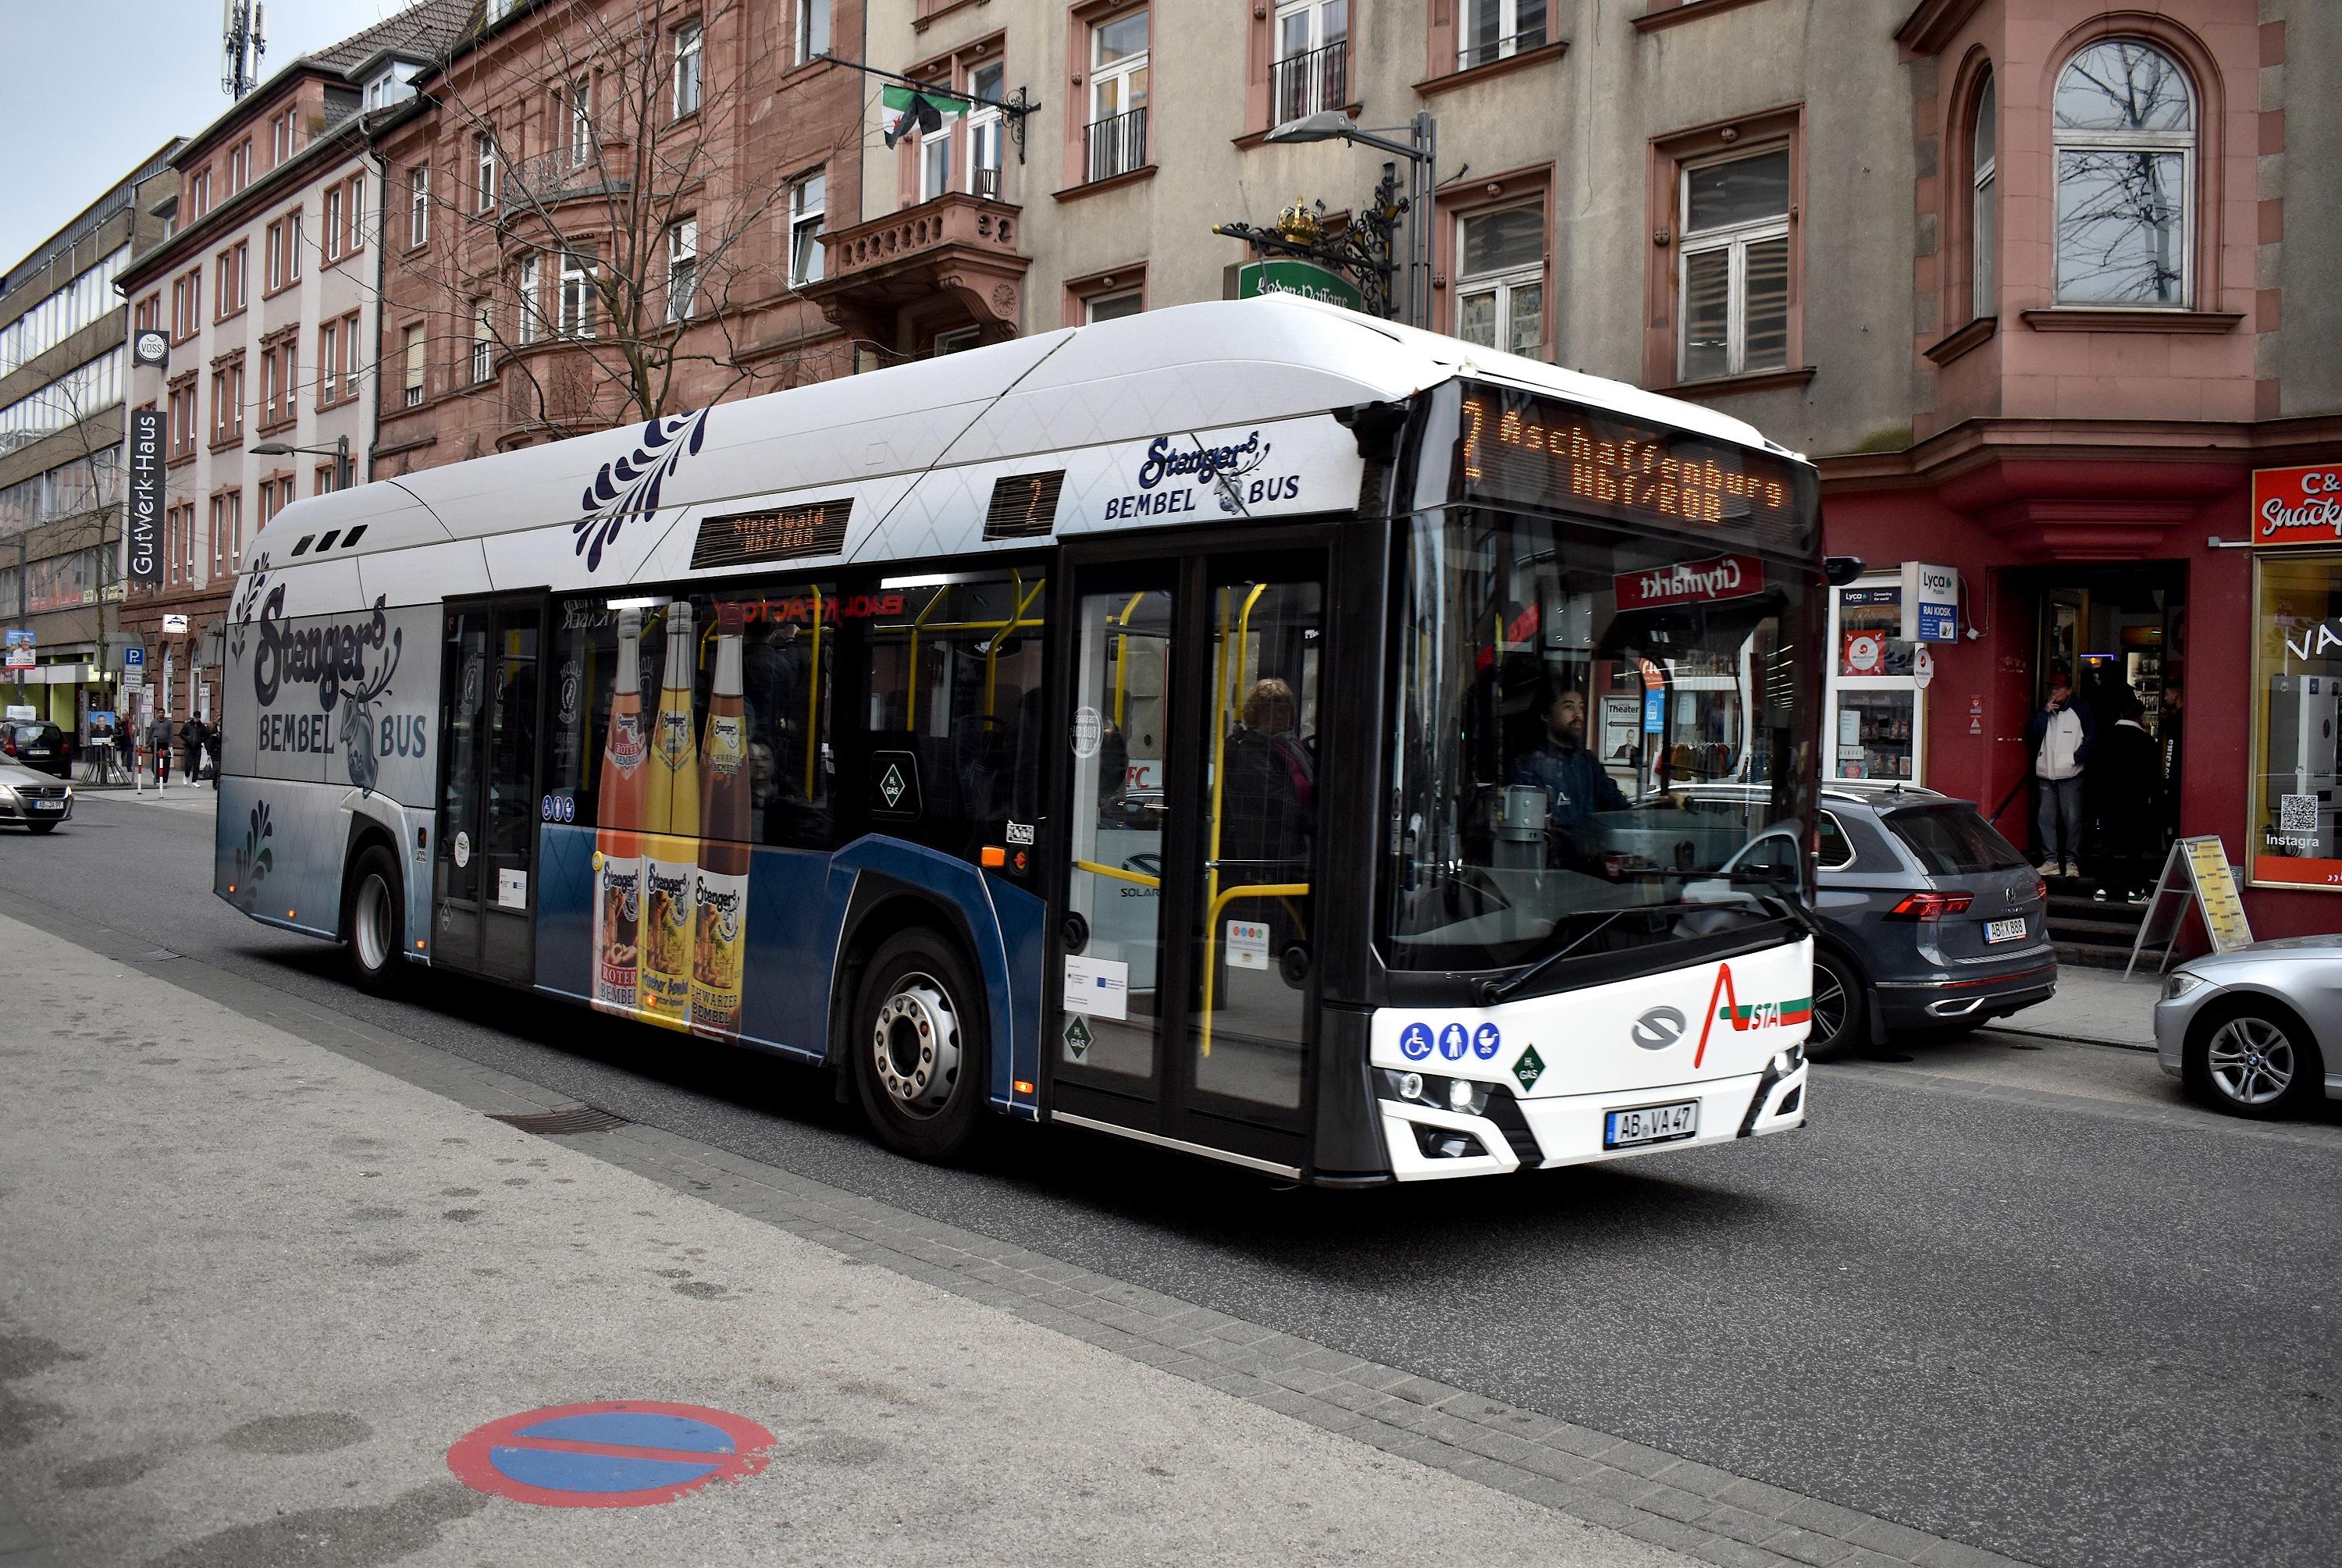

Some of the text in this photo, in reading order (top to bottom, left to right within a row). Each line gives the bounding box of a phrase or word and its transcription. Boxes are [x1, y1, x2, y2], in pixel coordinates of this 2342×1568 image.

[141, 343, 162, 354] VOSS
[1500, 410, 1781, 508] Aschaffenburg
[133, 415, 156, 574] GutWerk-Haus
[1104, 475, 1300, 521] BEMBEL BUS
[1924, 571, 1945, 590] Lyca
[1845, 592, 1863, 601] Lyca
[1923, 605, 1952, 617] RAJ KIOSK
[1608, 704, 1639, 714] Theater
[258, 713, 427, 759] BEMBEL BUS
[615, 743, 639, 754] ROTER
[886, 787, 899, 795] GAS
[2266, 833, 2319, 849] Instagra
[1991, 919, 2023, 937] AB X 888
[602, 965, 637, 985] ROTER
[1070, 1037, 1087, 1049] GAS
[1518, 1068, 1539, 1082] GAS
[1620, 1113, 1641, 1139] AB
[1651, 1109, 1670, 1134] VA
[1672, 1106, 1691, 1131] 47
